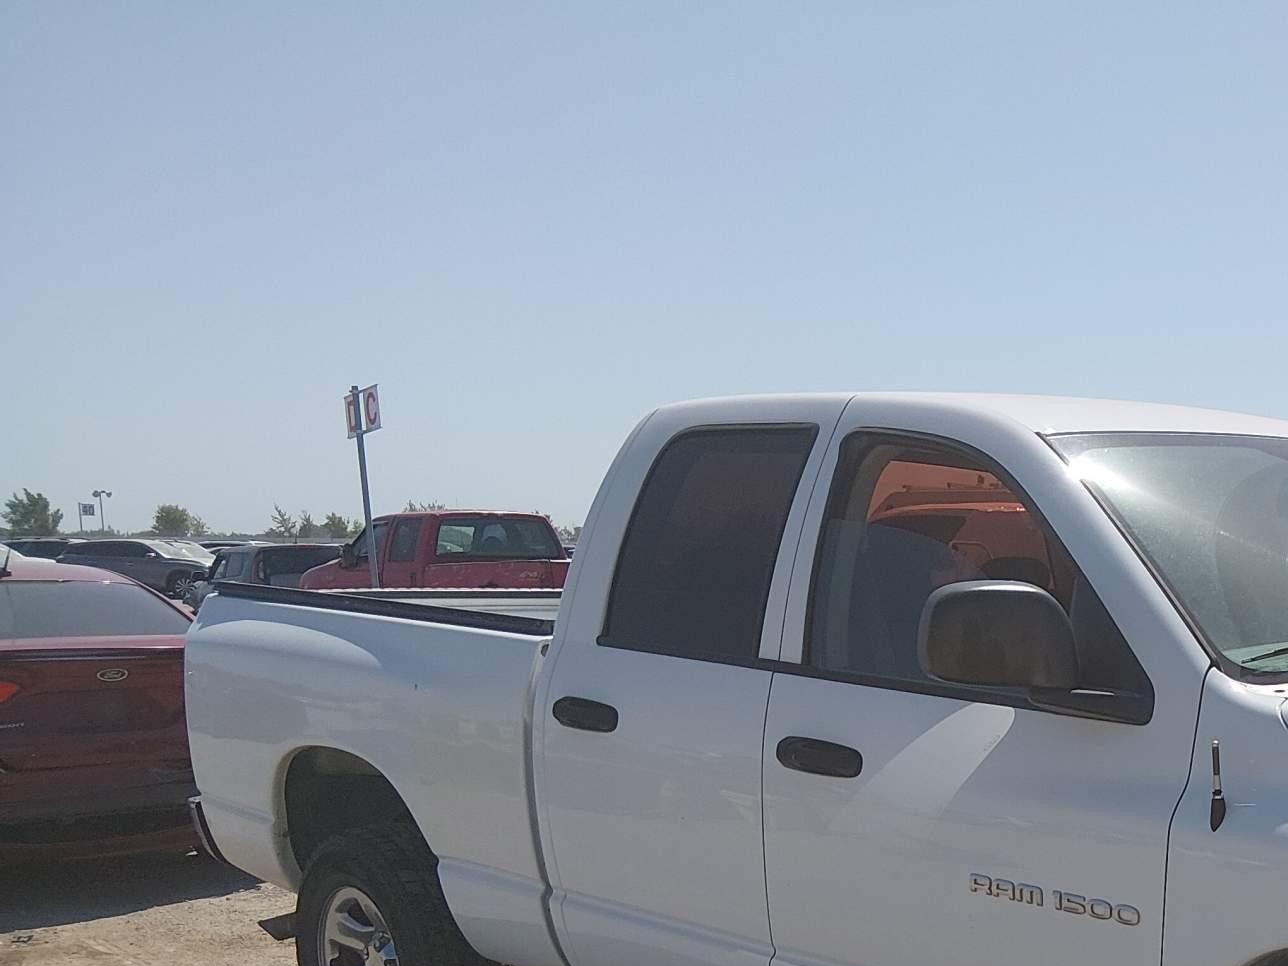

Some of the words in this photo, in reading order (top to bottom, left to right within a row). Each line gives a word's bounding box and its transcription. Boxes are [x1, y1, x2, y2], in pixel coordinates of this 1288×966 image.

[366, 391, 378, 426] C
[969, 872, 1044, 907] RAM
[1053, 889, 1141, 927] 1500
